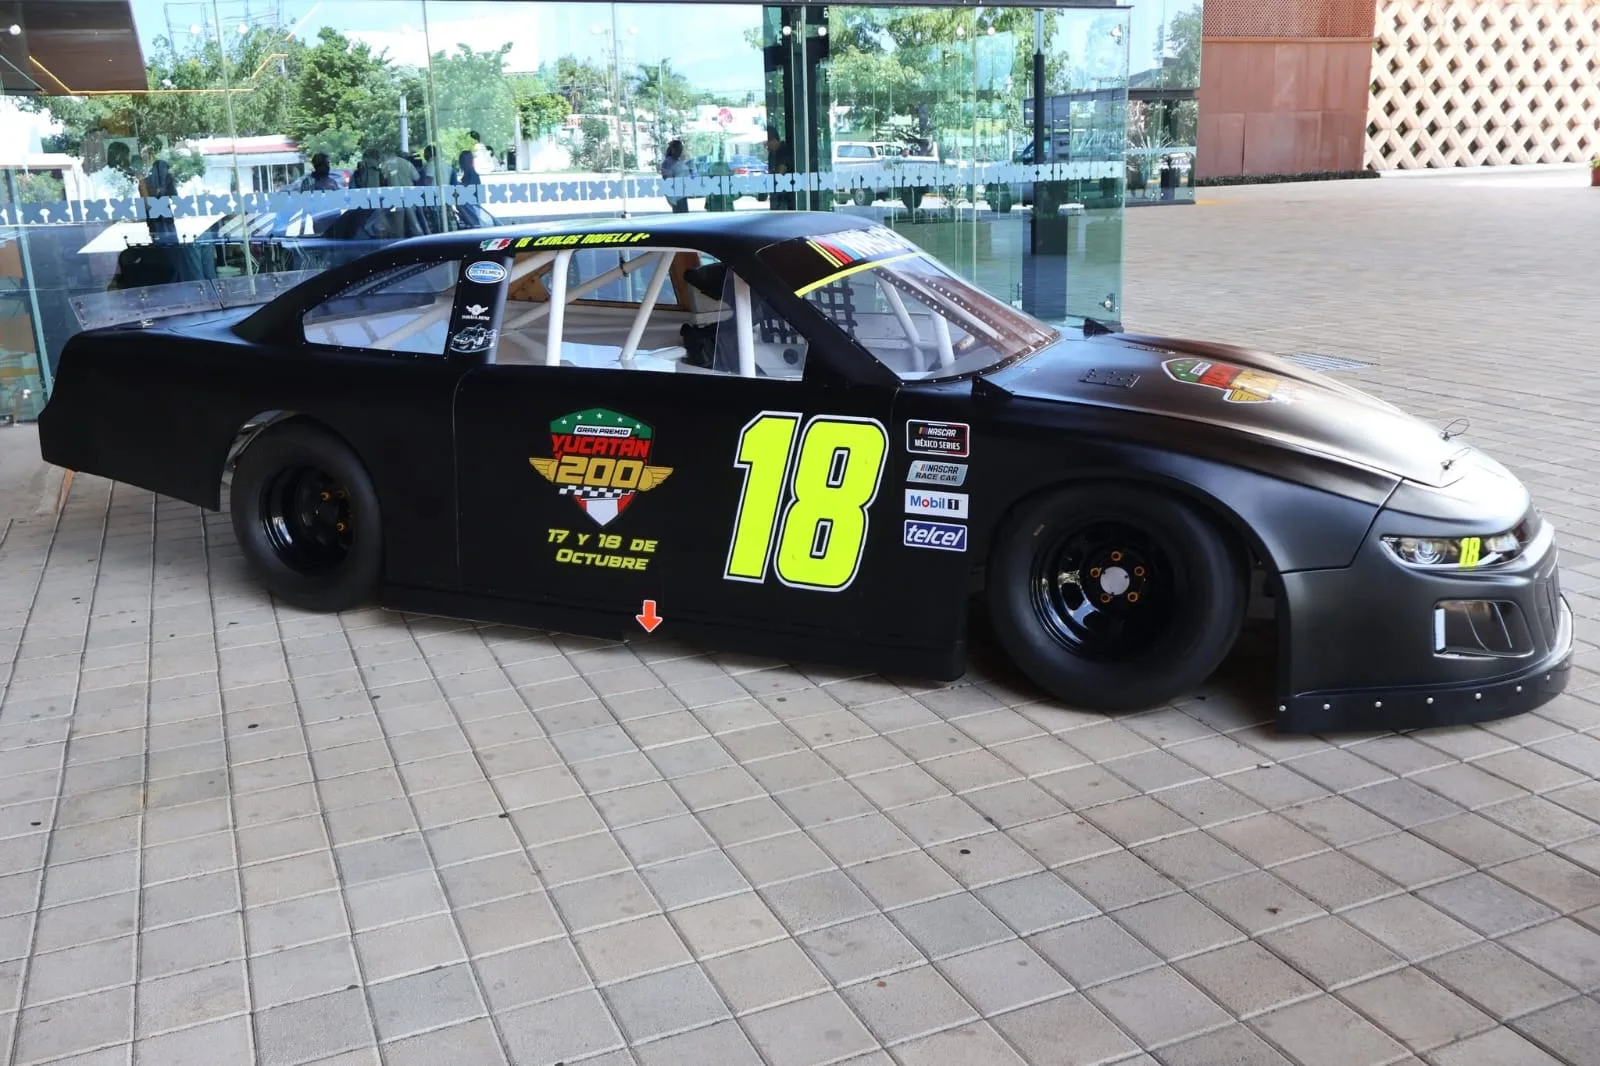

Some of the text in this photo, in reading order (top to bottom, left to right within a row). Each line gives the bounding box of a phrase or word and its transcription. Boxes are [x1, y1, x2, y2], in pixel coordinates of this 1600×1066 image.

[533, 235, 582, 246] CARLOS
[580, 233, 632, 244] NOVELO
[576, 426, 599, 434] GRAN
[928, 427, 957, 437] NASCAR
[551, 435, 650, 457] YUCATÁN
[915, 438, 960, 450] MÉXICO SERIES
[554, 455, 645, 489] 200
[915, 472, 938, 480] RACE
[928, 464, 959, 474] NASCAR
[723, 411, 889, 592] 18
[910, 495, 945, 509] Mobil
[548, 528, 569, 543] 17
[577, 534, 590, 546] Y
[630, 539, 658, 552] DE
[907, 525, 964, 546] telcel
[556, 549, 649, 570] OCTUBRE
[1459, 537, 1481, 567] 18
